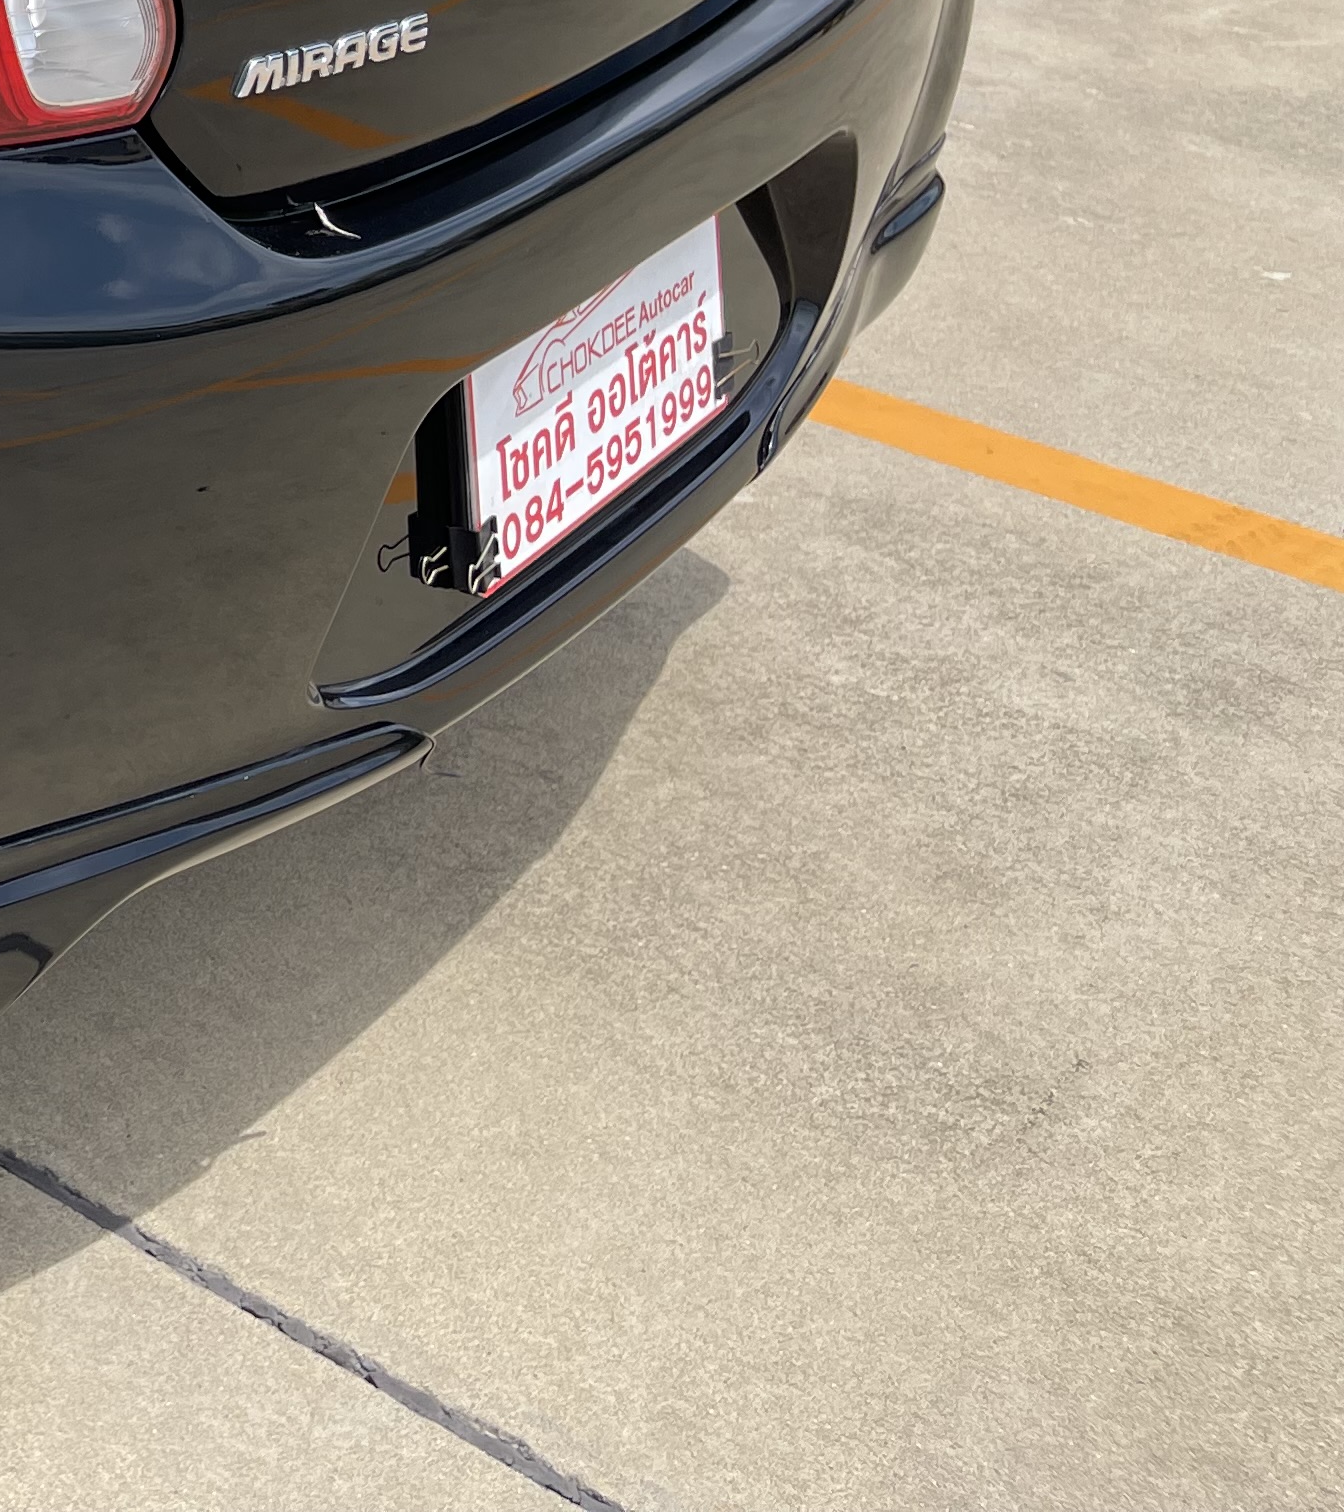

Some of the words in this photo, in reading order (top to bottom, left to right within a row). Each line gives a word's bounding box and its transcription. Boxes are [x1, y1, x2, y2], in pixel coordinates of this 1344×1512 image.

[234, 12, 429, 99] MIRAGE
[496, 391, 576, 502] โชคดี
[587, 290, 708, 434] ออโต้คาร์
[546, 306, 636, 394] CHOKDEE
[638, 271, 696, 331] Autocar
[502, 364, 712, 561] 084-5951999
